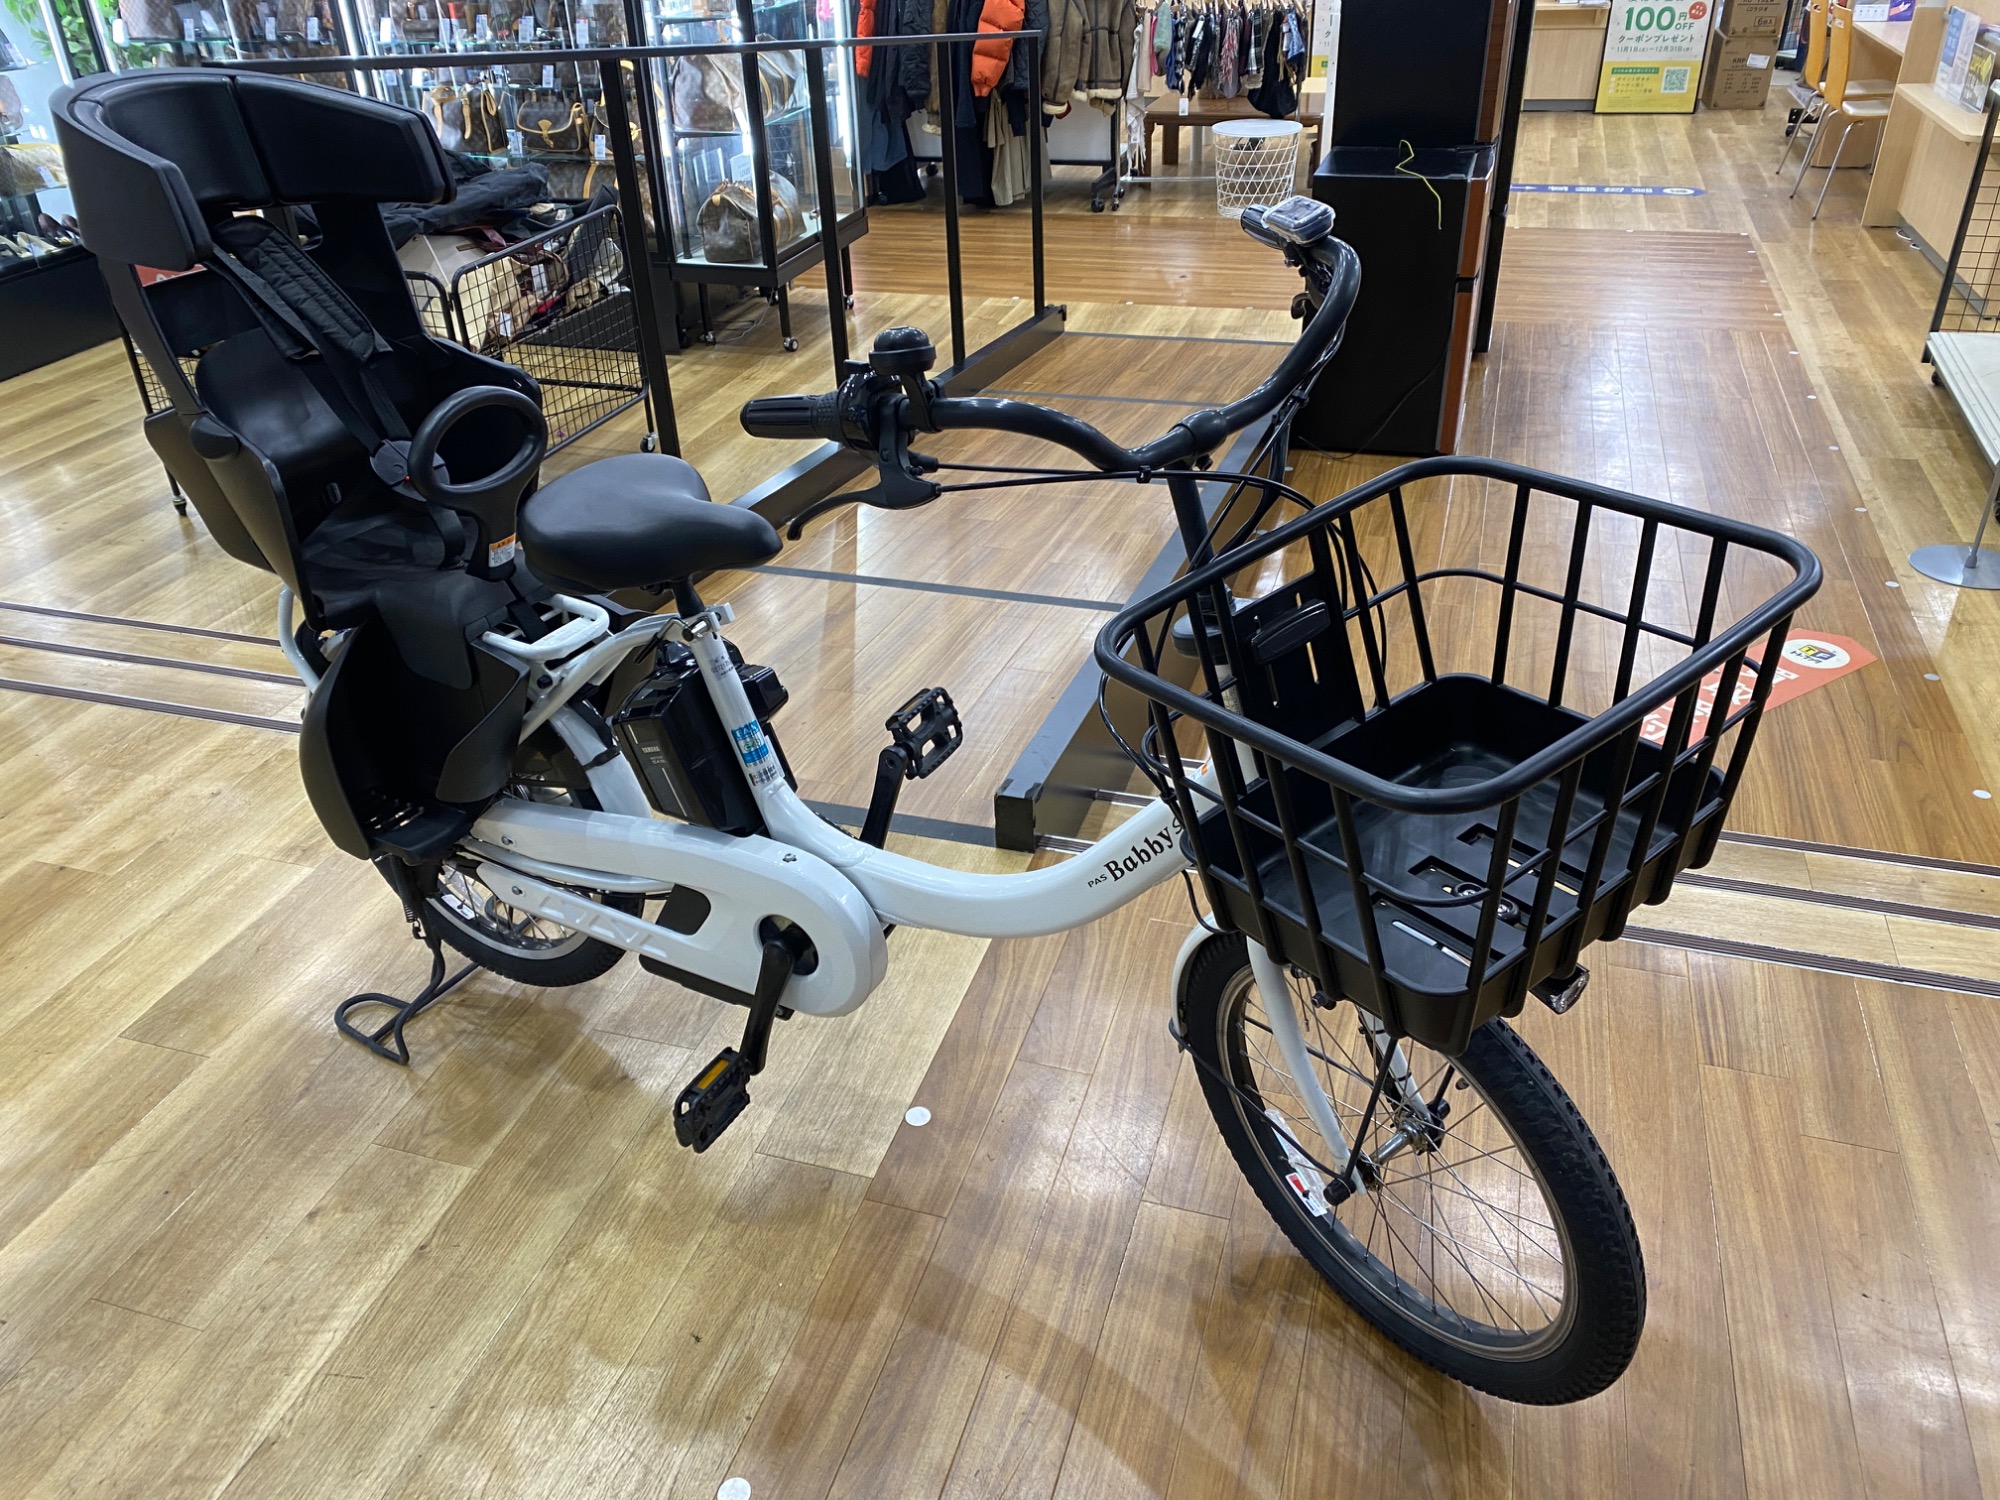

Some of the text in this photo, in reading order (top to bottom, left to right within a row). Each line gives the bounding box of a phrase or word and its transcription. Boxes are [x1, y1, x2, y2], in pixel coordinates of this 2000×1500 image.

[1625, 6, 1676, 31] 100
[1675, 22, 1695, 31] OFF
[1618, 34, 1695, 44] クーポンプレゼント
[1087, 873, 1108, 888] PAS
[1103, 826, 1174, 882] Babby
